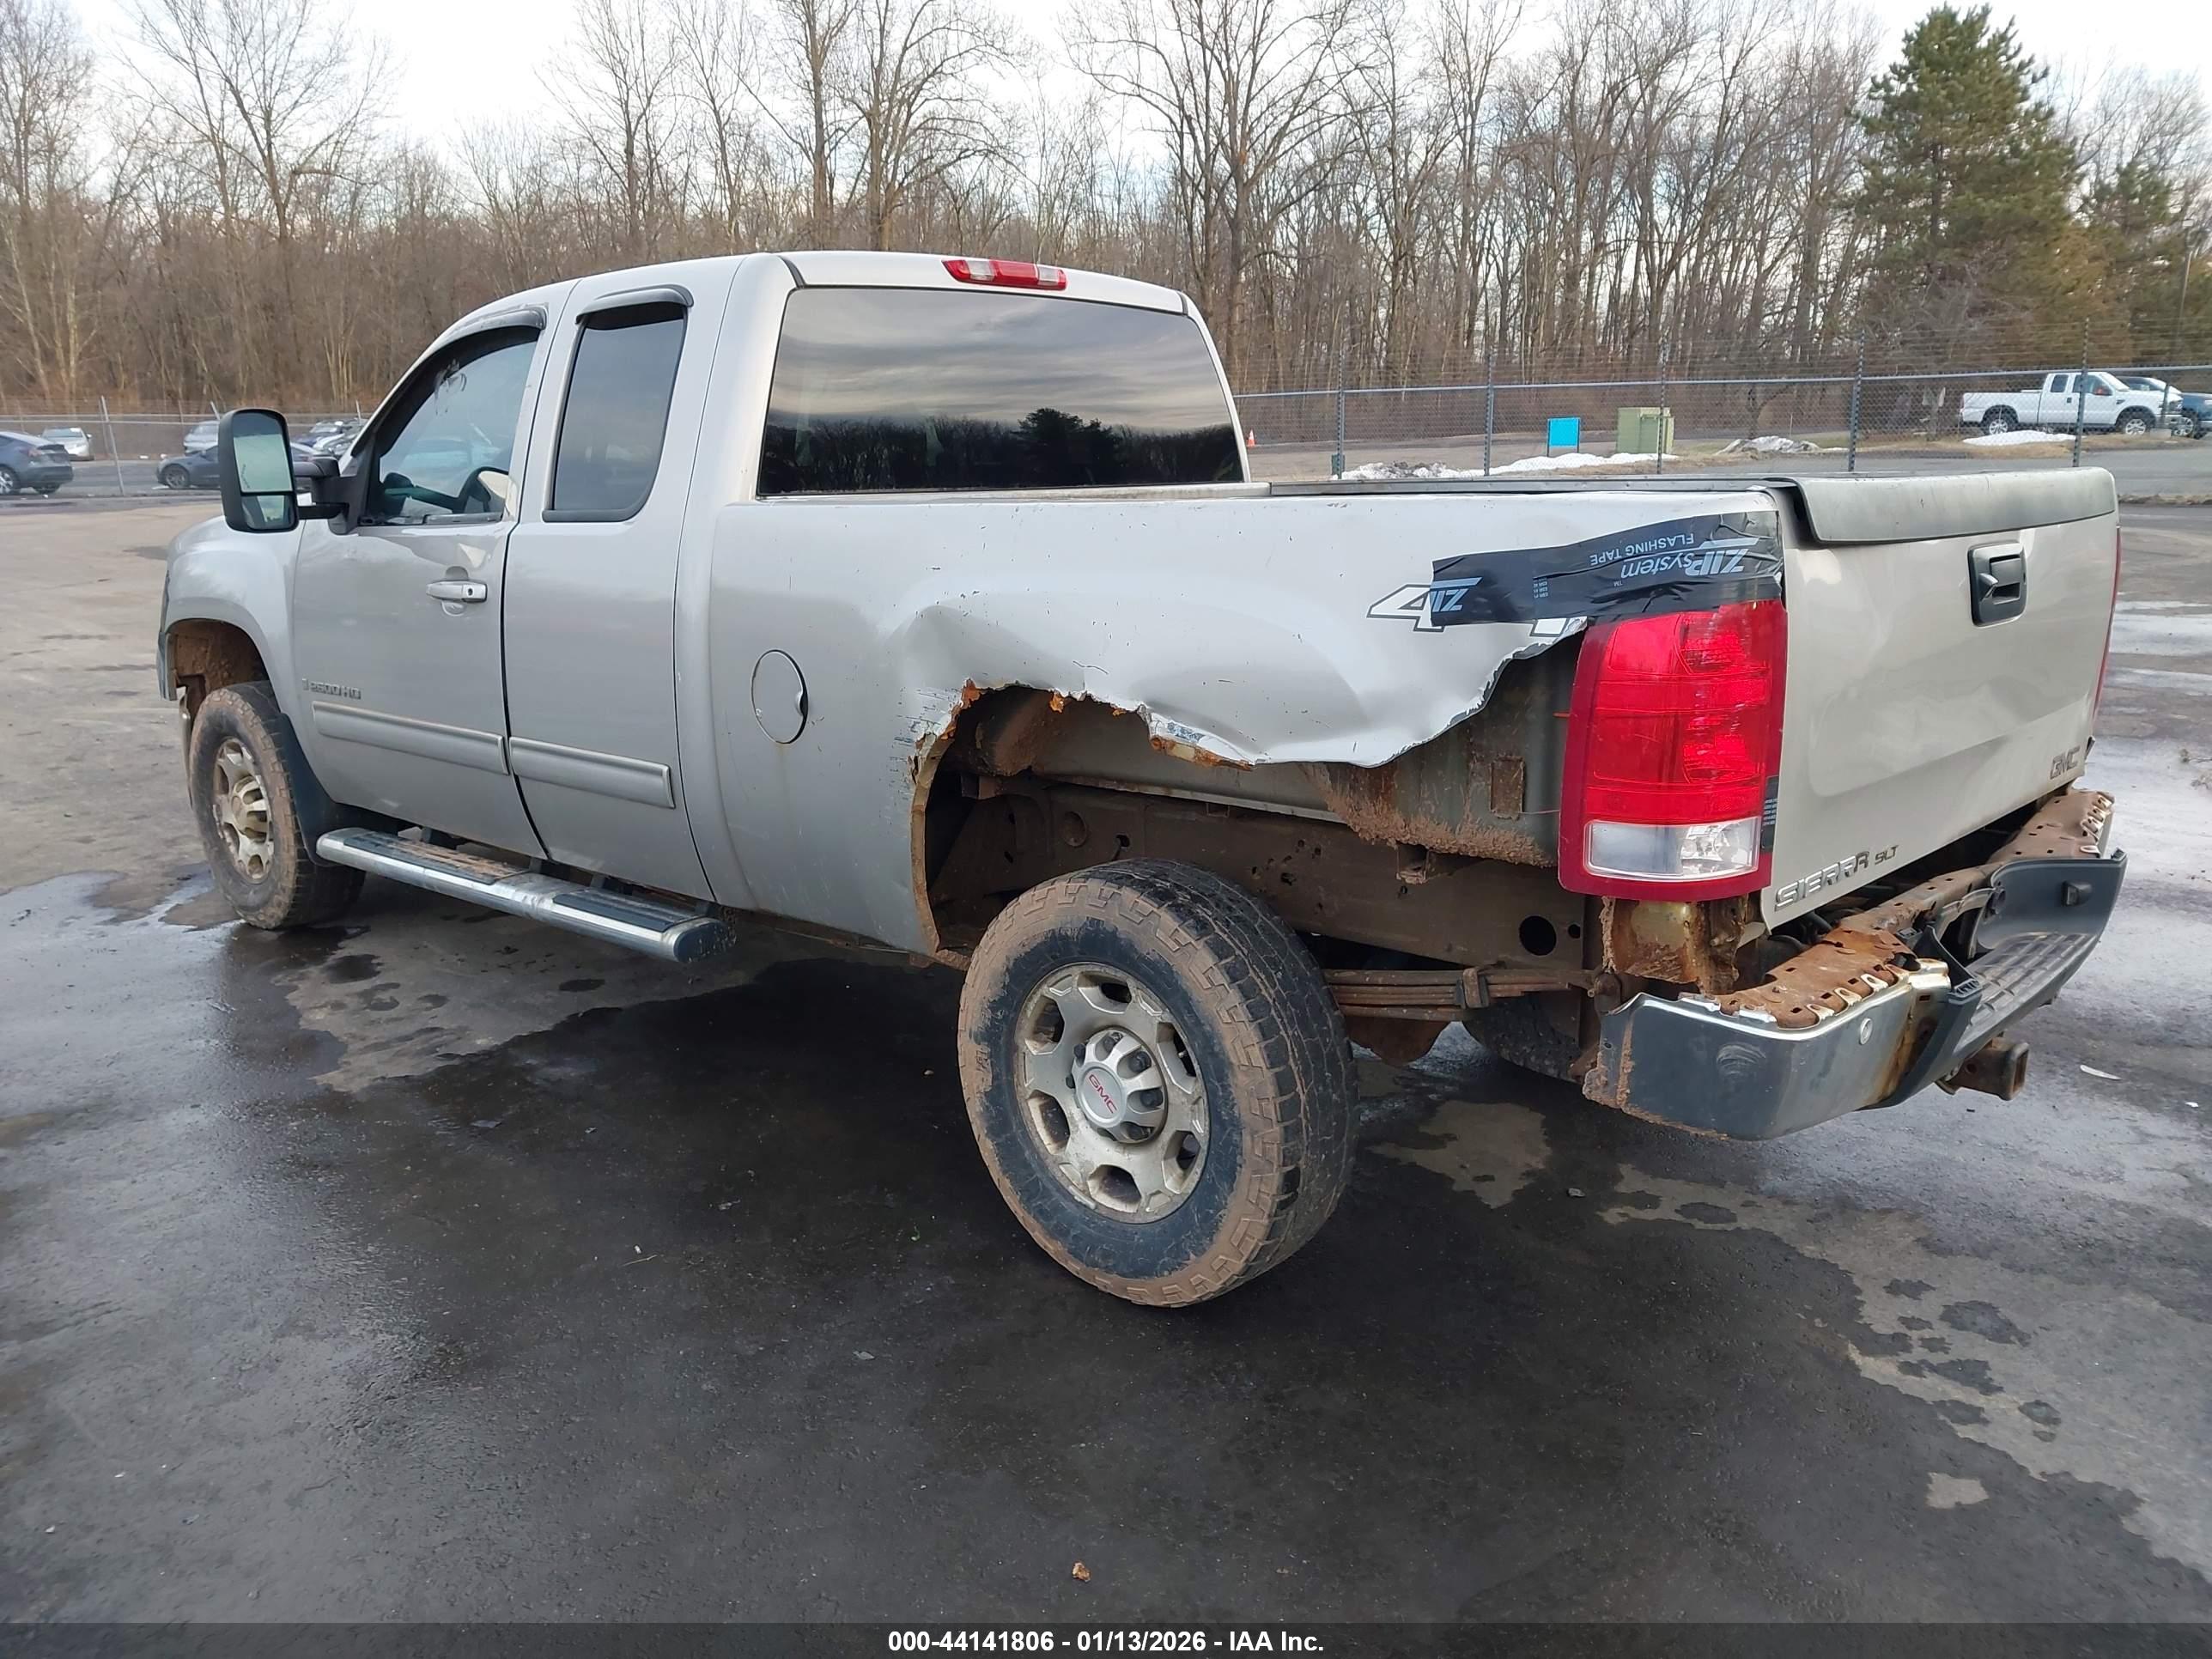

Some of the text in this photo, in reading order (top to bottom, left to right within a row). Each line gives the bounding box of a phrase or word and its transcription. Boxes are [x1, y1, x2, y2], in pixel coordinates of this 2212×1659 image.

[1590, 533, 1694, 566] FLASHING TAPE
[2050, 746, 2080, 780] GMC
[1775, 845, 1899, 912] SIERRA SLT
[1089, 1074, 1117, 1114] GMC
